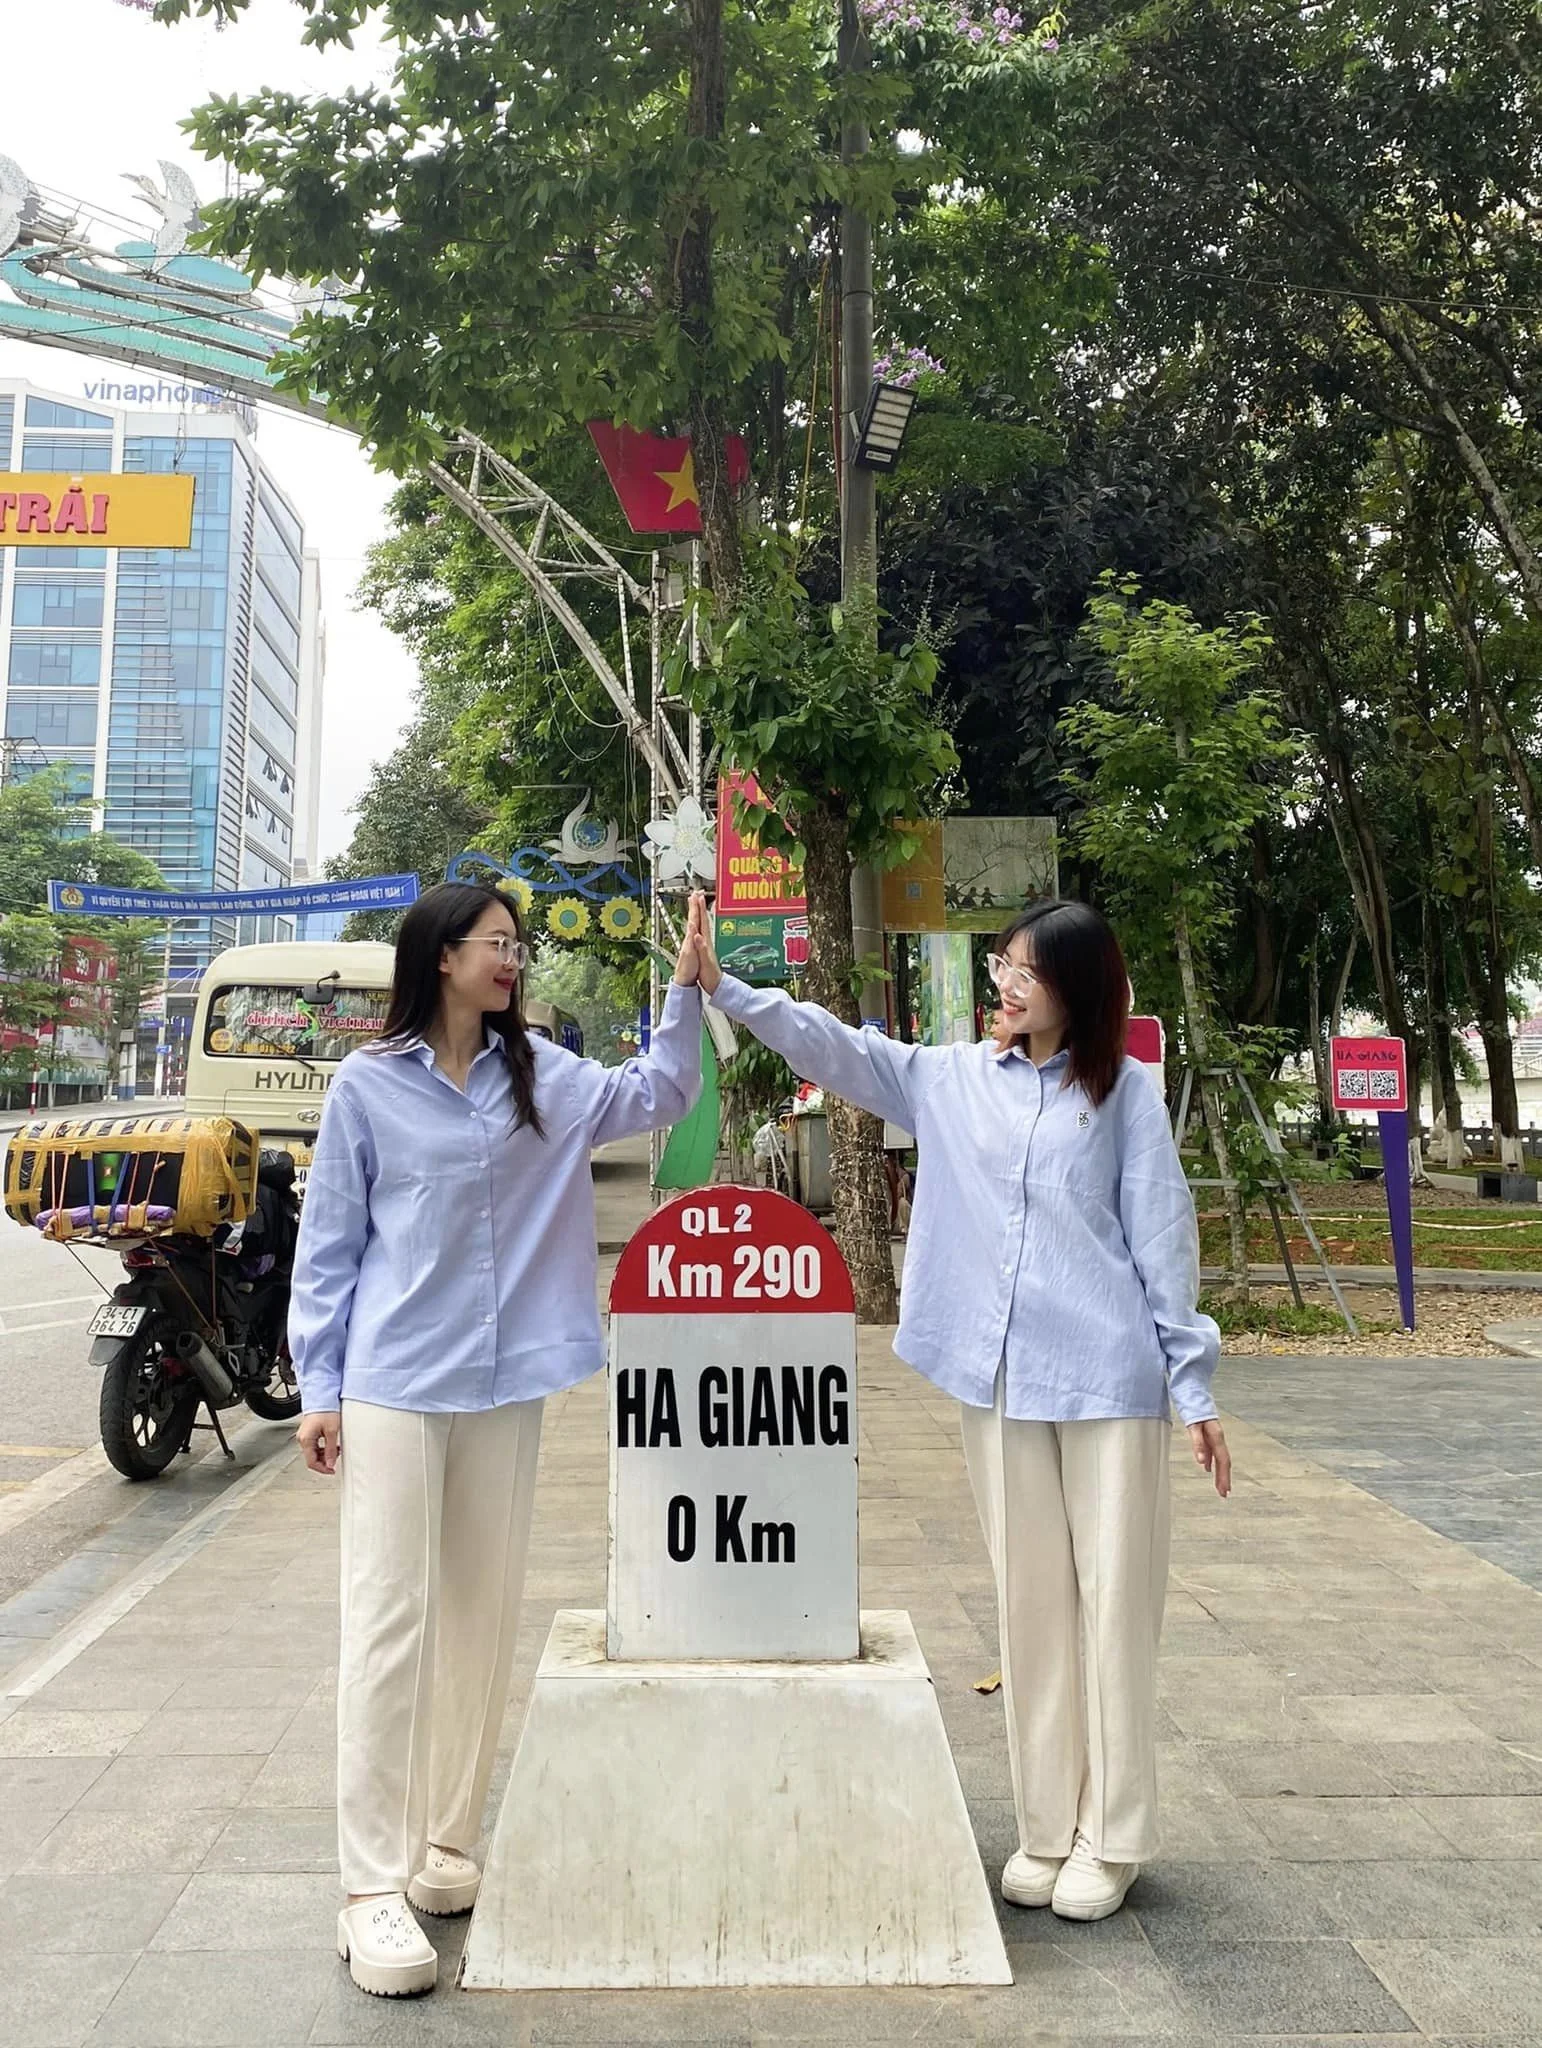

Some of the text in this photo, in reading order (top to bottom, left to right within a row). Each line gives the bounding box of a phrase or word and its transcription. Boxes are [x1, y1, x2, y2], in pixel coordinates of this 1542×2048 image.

[729, 856, 782, 876] QUAG
[647, 1244, 821, 1299] Km 290
[617, 1365, 849, 1448] HA GIANG
[667, 1494, 796, 1563] 0 Km
